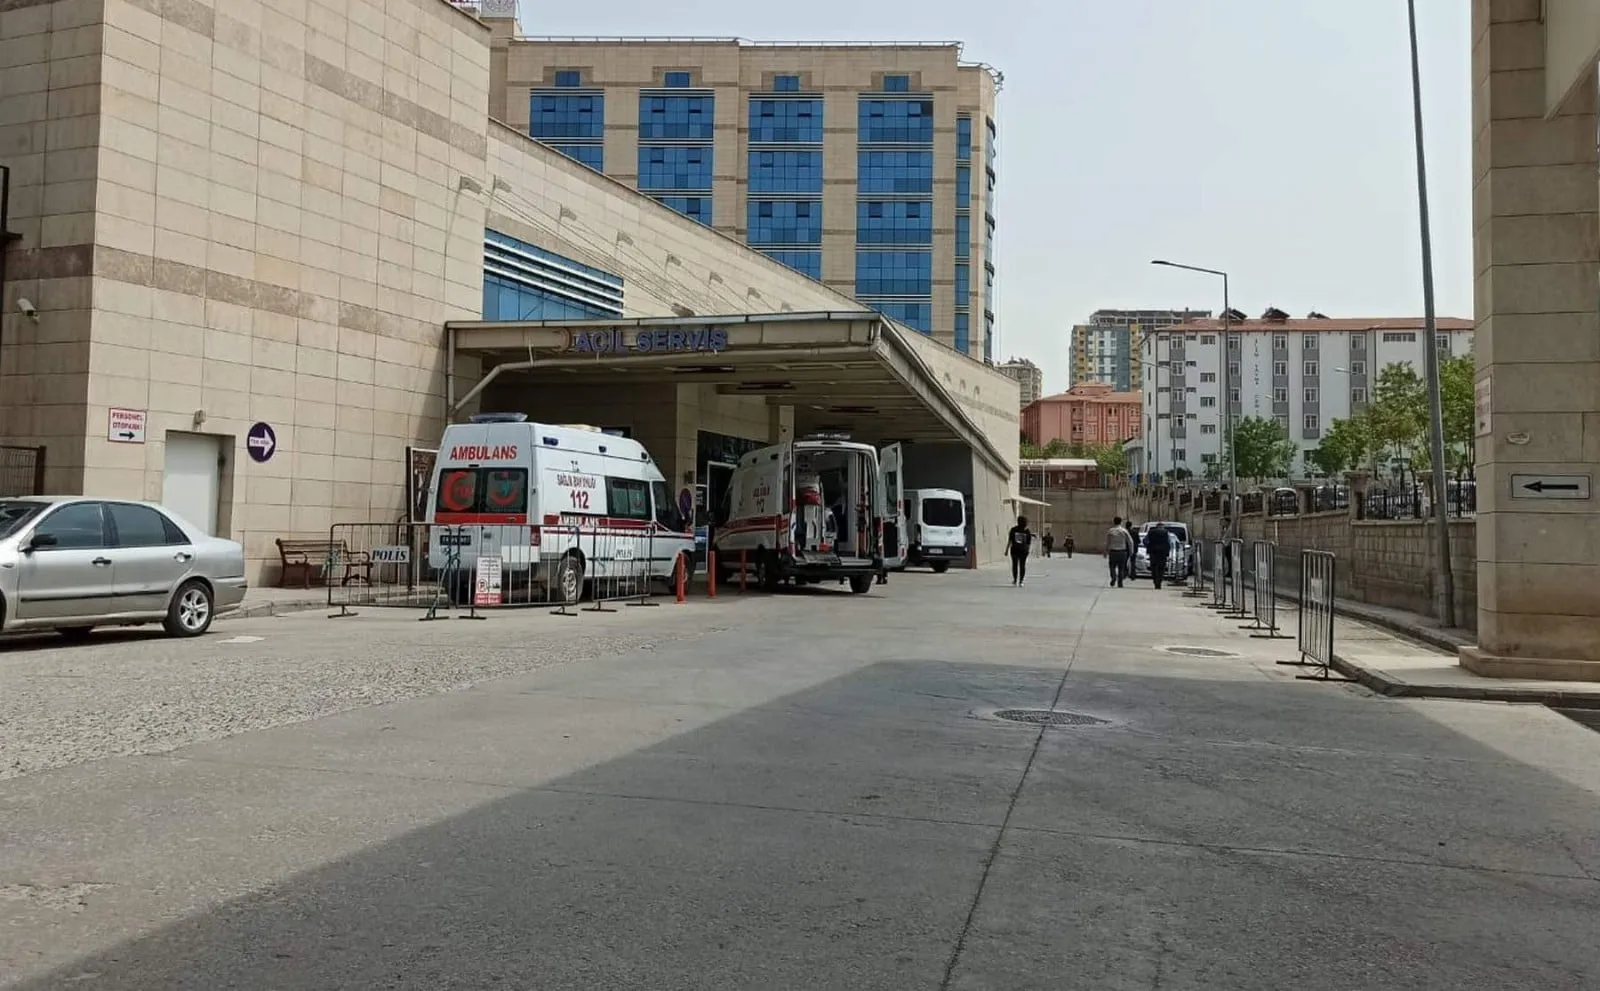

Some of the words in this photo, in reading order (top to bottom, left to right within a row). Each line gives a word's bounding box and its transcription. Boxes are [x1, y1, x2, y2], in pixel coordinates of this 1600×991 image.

[450, 445, 517, 460] AMBULANS
[570, 490, 589, 509] 112
[371, 547, 407, 561] POLİS
